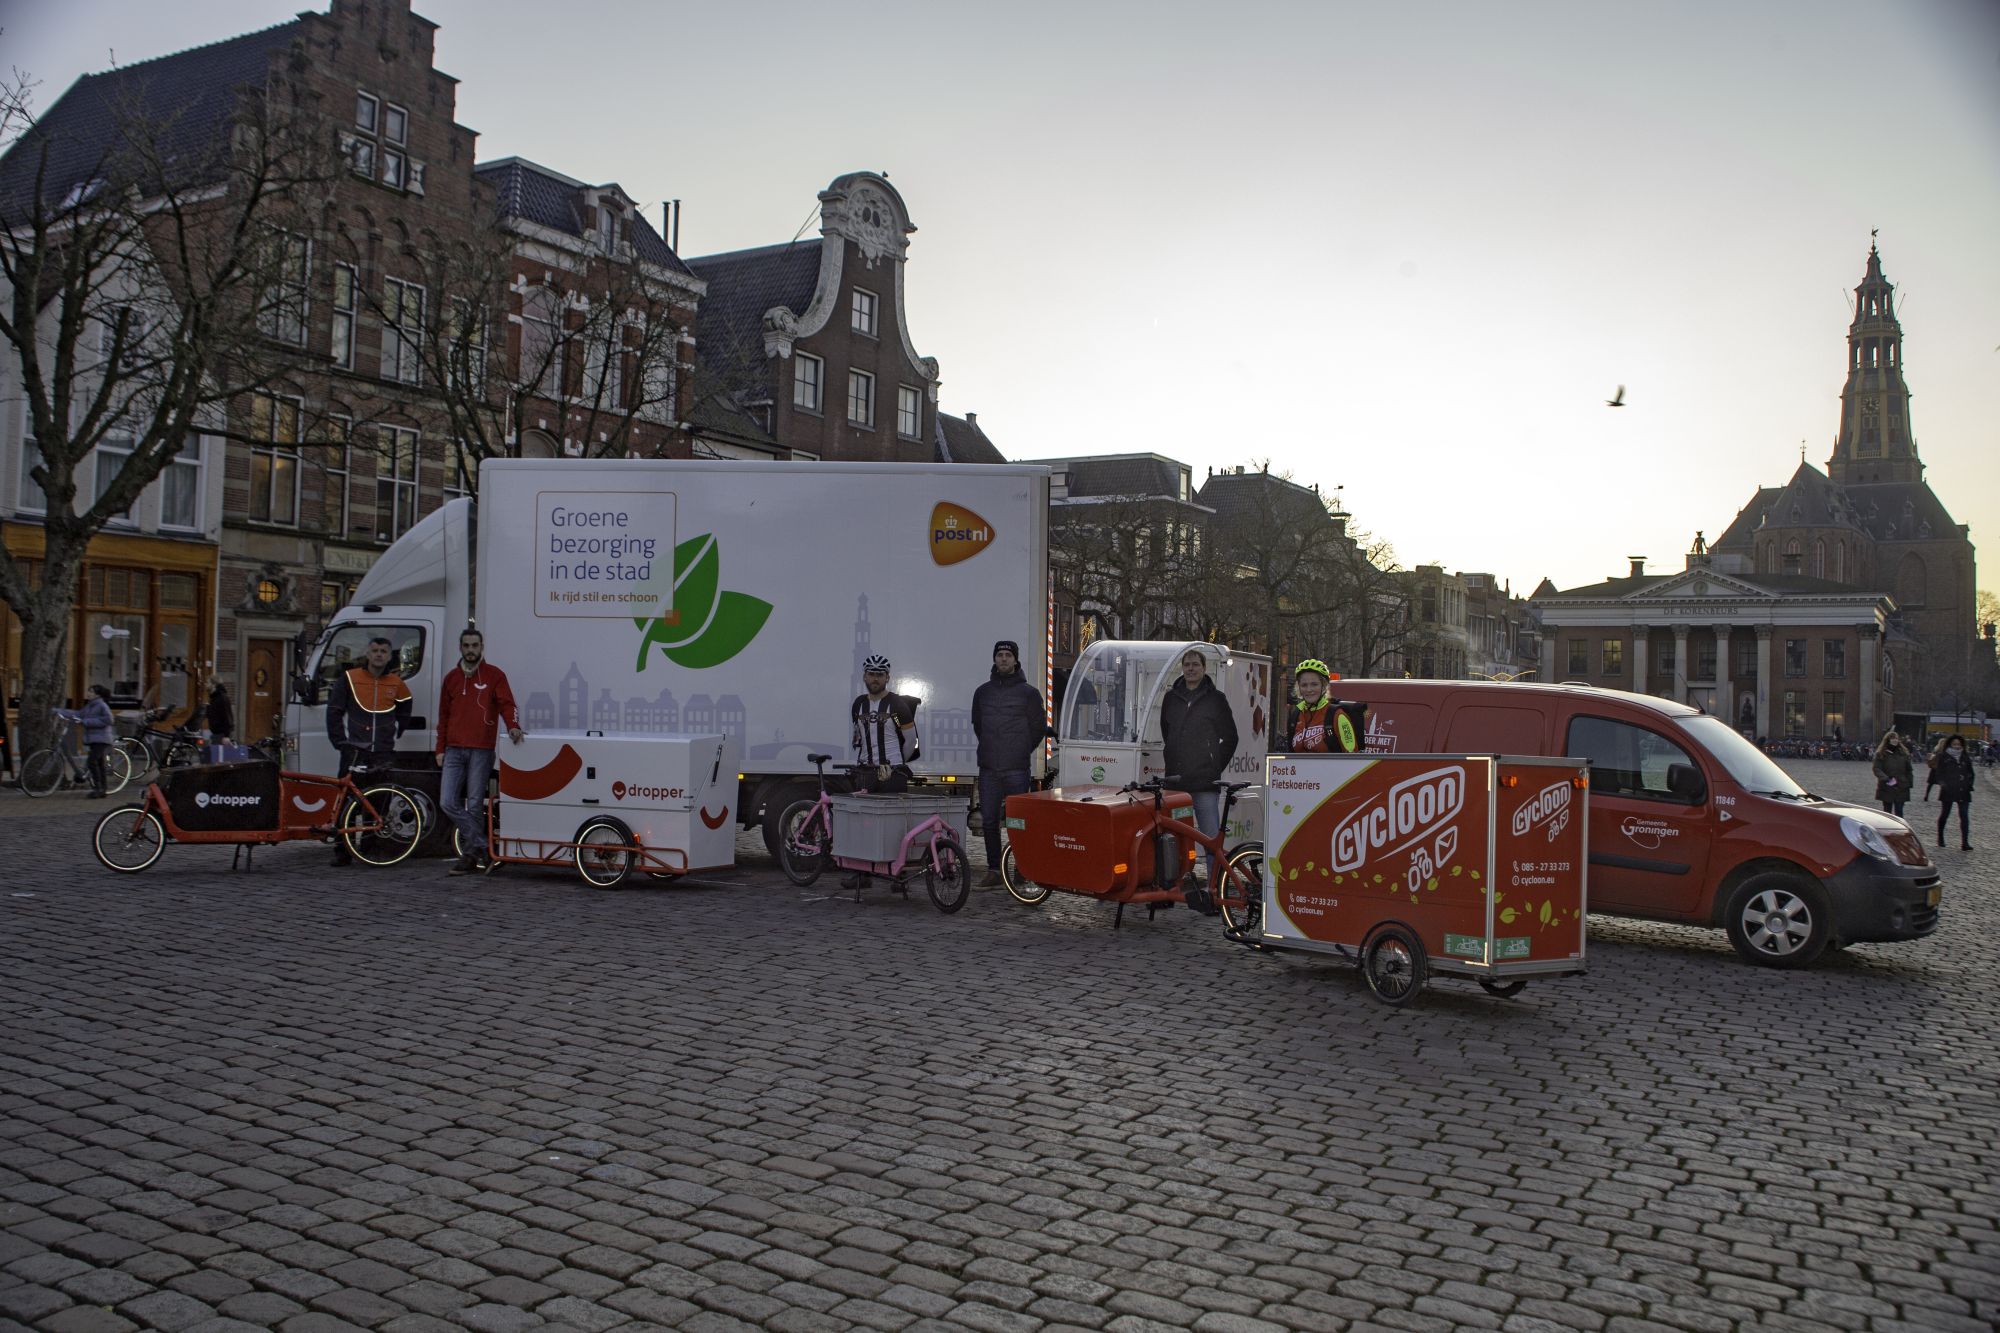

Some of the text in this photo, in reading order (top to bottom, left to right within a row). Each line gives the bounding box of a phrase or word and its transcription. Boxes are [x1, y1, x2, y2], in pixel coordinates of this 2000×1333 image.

[551, 507, 629, 527] Groene
[934, 526, 988, 544] postnl
[551, 533, 656, 559] bezorging
[550, 560, 650, 580] in de stad
[550, 592, 658, 604] Ik rijd stil en schoon
[1364, 736, 1392, 746] DER MET
[1272, 765, 1297, 776] Post &
[1271, 779, 1321, 790] Fietskoeriers
[628, 783, 684, 801] dropper
[210, 793, 261, 806] dropper
[1715, 795, 1736, 806] 11846
[1512, 780, 1571, 836] cycloon
[1332, 766, 1465, 873] cycloon
[1620, 825, 1679, 838] Groningen
[1521, 862, 1535, 872] 085
[1540, 862, 1549, 871] 27
[1549, 862, 1557, 871] 33
[1558, 862, 1570, 871] 273
[1521, 876, 1555, 886] cycloon.eu
[1296, 895, 1307, 904] 085
[1310, 897, 1318, 905] 27
[1319, 898, 1326, 906] 33
[1327, 899, 1338, 907] 273
[1295, 906, 1324, 916] cycloon.eu
